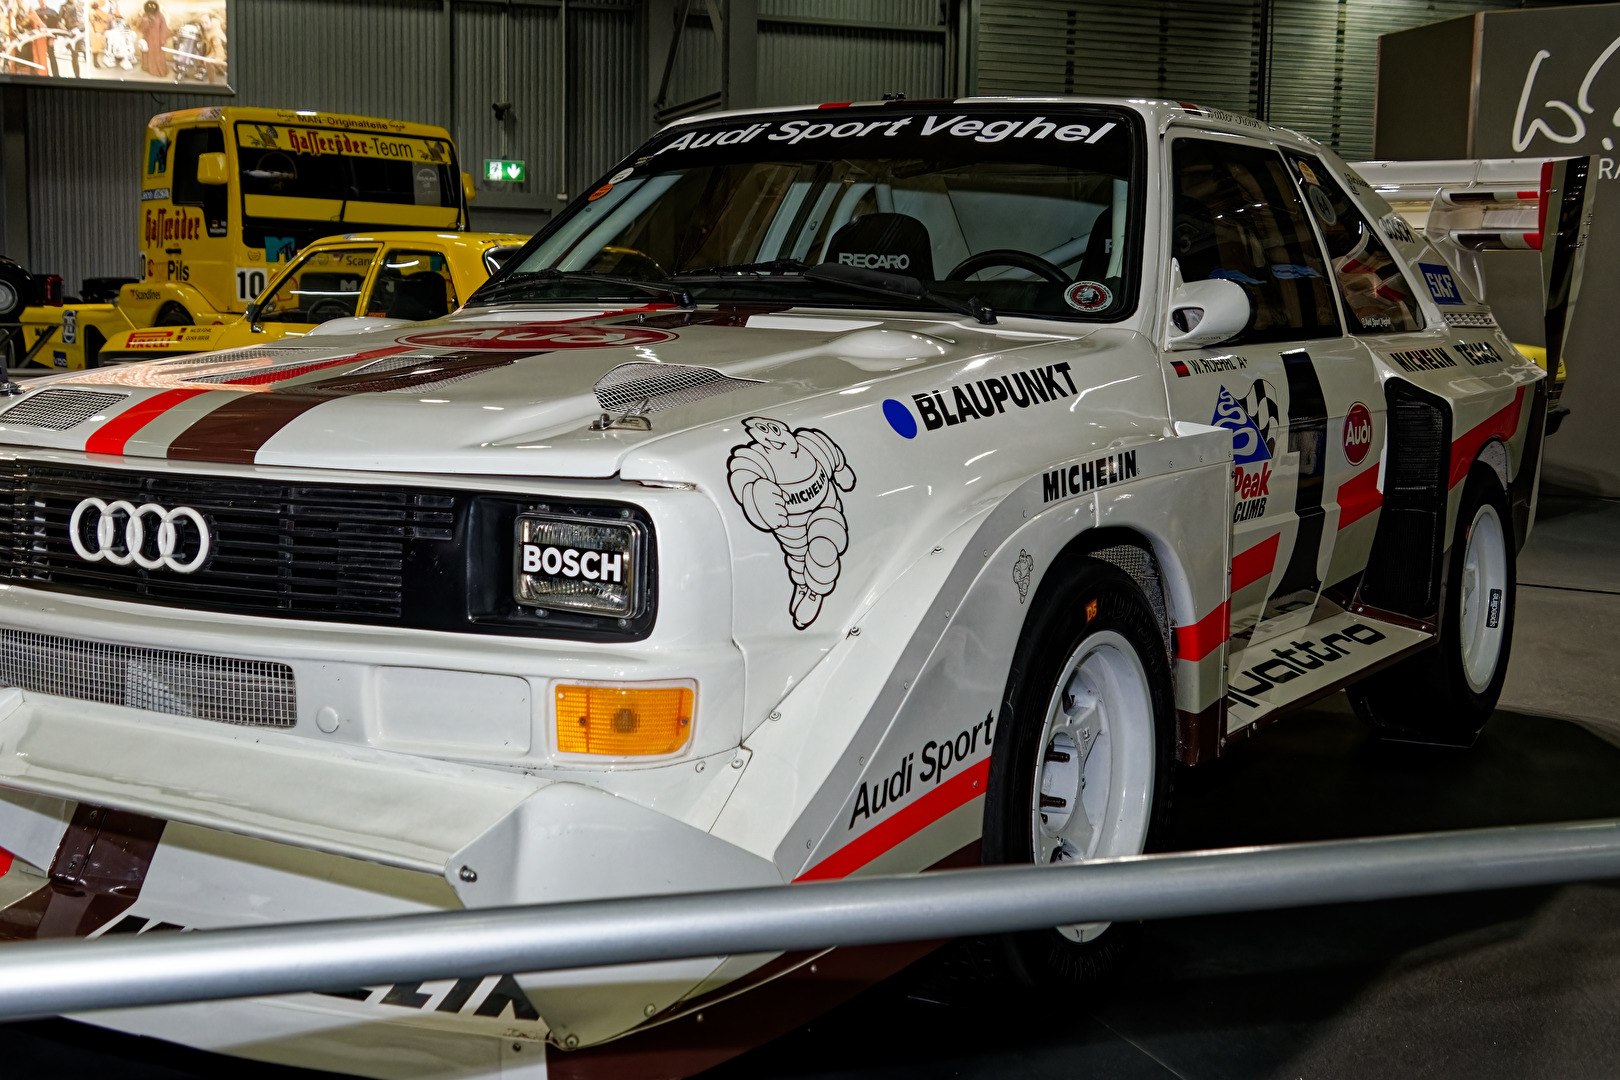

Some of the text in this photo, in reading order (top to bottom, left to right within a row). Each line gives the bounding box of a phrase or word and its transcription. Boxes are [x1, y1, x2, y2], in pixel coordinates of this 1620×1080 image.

[653, 115, 1117, 156] Audi Sport Veghel
[168, 260, 190, 281] Pils
[838, 252, 910, 270] RECARO
[237, 271, 265, 300] 10
[1425, 272, 1455, 298] SKF
[125, 331, 174, 348] PIRELLI
[1389, 347, 1458, 373] MICHELIN
[911, 361, 1079, 432] BLAUPUNKT
[1344, 421, 1371, 447] Audi
[786, 469, 826, 506] MICHELIN
[1042, 449, 1138, 503] MICHELIN
[1234, 461, 1273, 500] Peak
[1234, 497, 1267, 524] CLIMB
[523, 544, 622, 582] BOSCH
[1086, 603, 1097, 621] D5
[1489, 592, 1501, 628] speedline
[848, 708, 994, 831] Audi Sport
